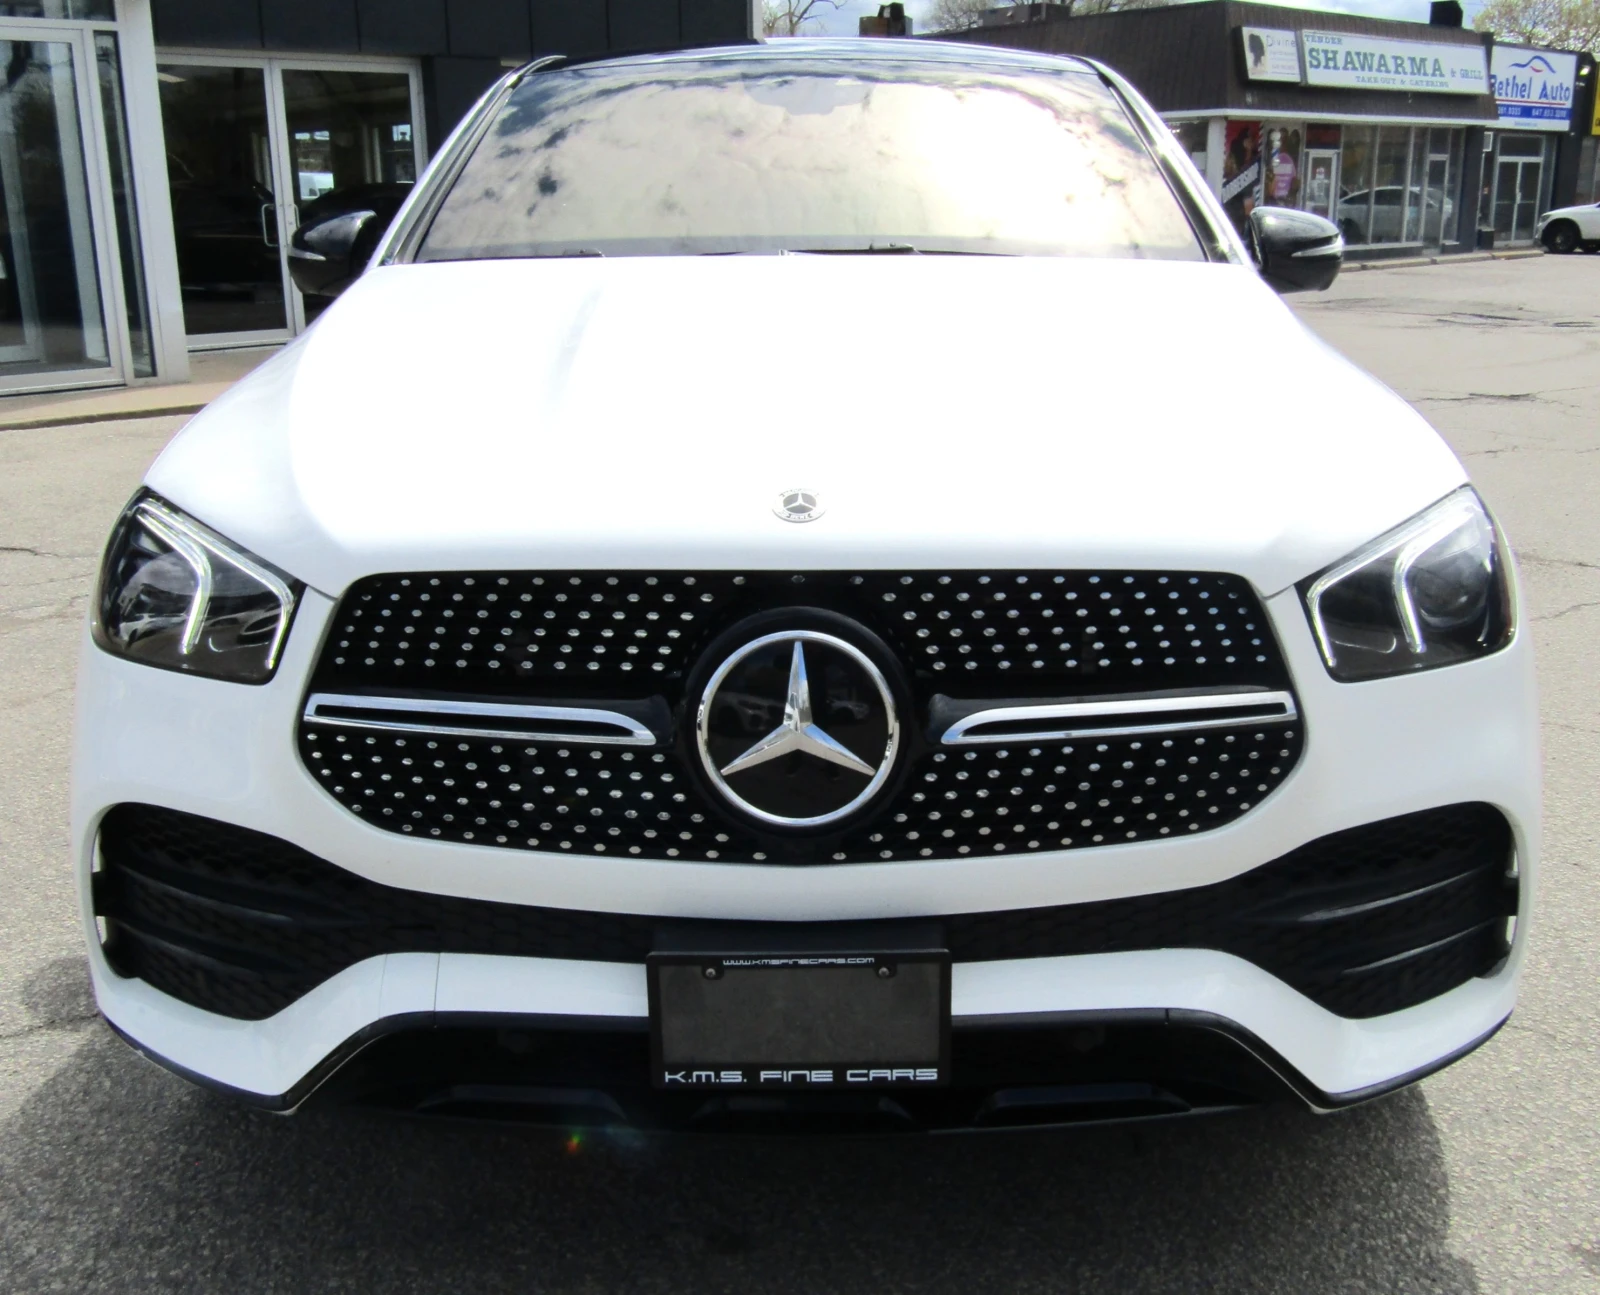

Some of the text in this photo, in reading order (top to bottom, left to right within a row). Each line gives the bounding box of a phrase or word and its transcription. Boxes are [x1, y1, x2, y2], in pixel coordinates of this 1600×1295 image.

[1266, 34, 1296, 47] Divine
[1304, 34, 1343, 45] TENDER
[1308, 47, 1445, 78] SHAWARMA
[1459, 68, 1484, 80] GRILL
[1409, 79, 1449, 88] CATERING
[1489, 74, 1571, 101] Bethel Auto
[664, 1068, 939, 1083] K.M.S. FINE CARS
